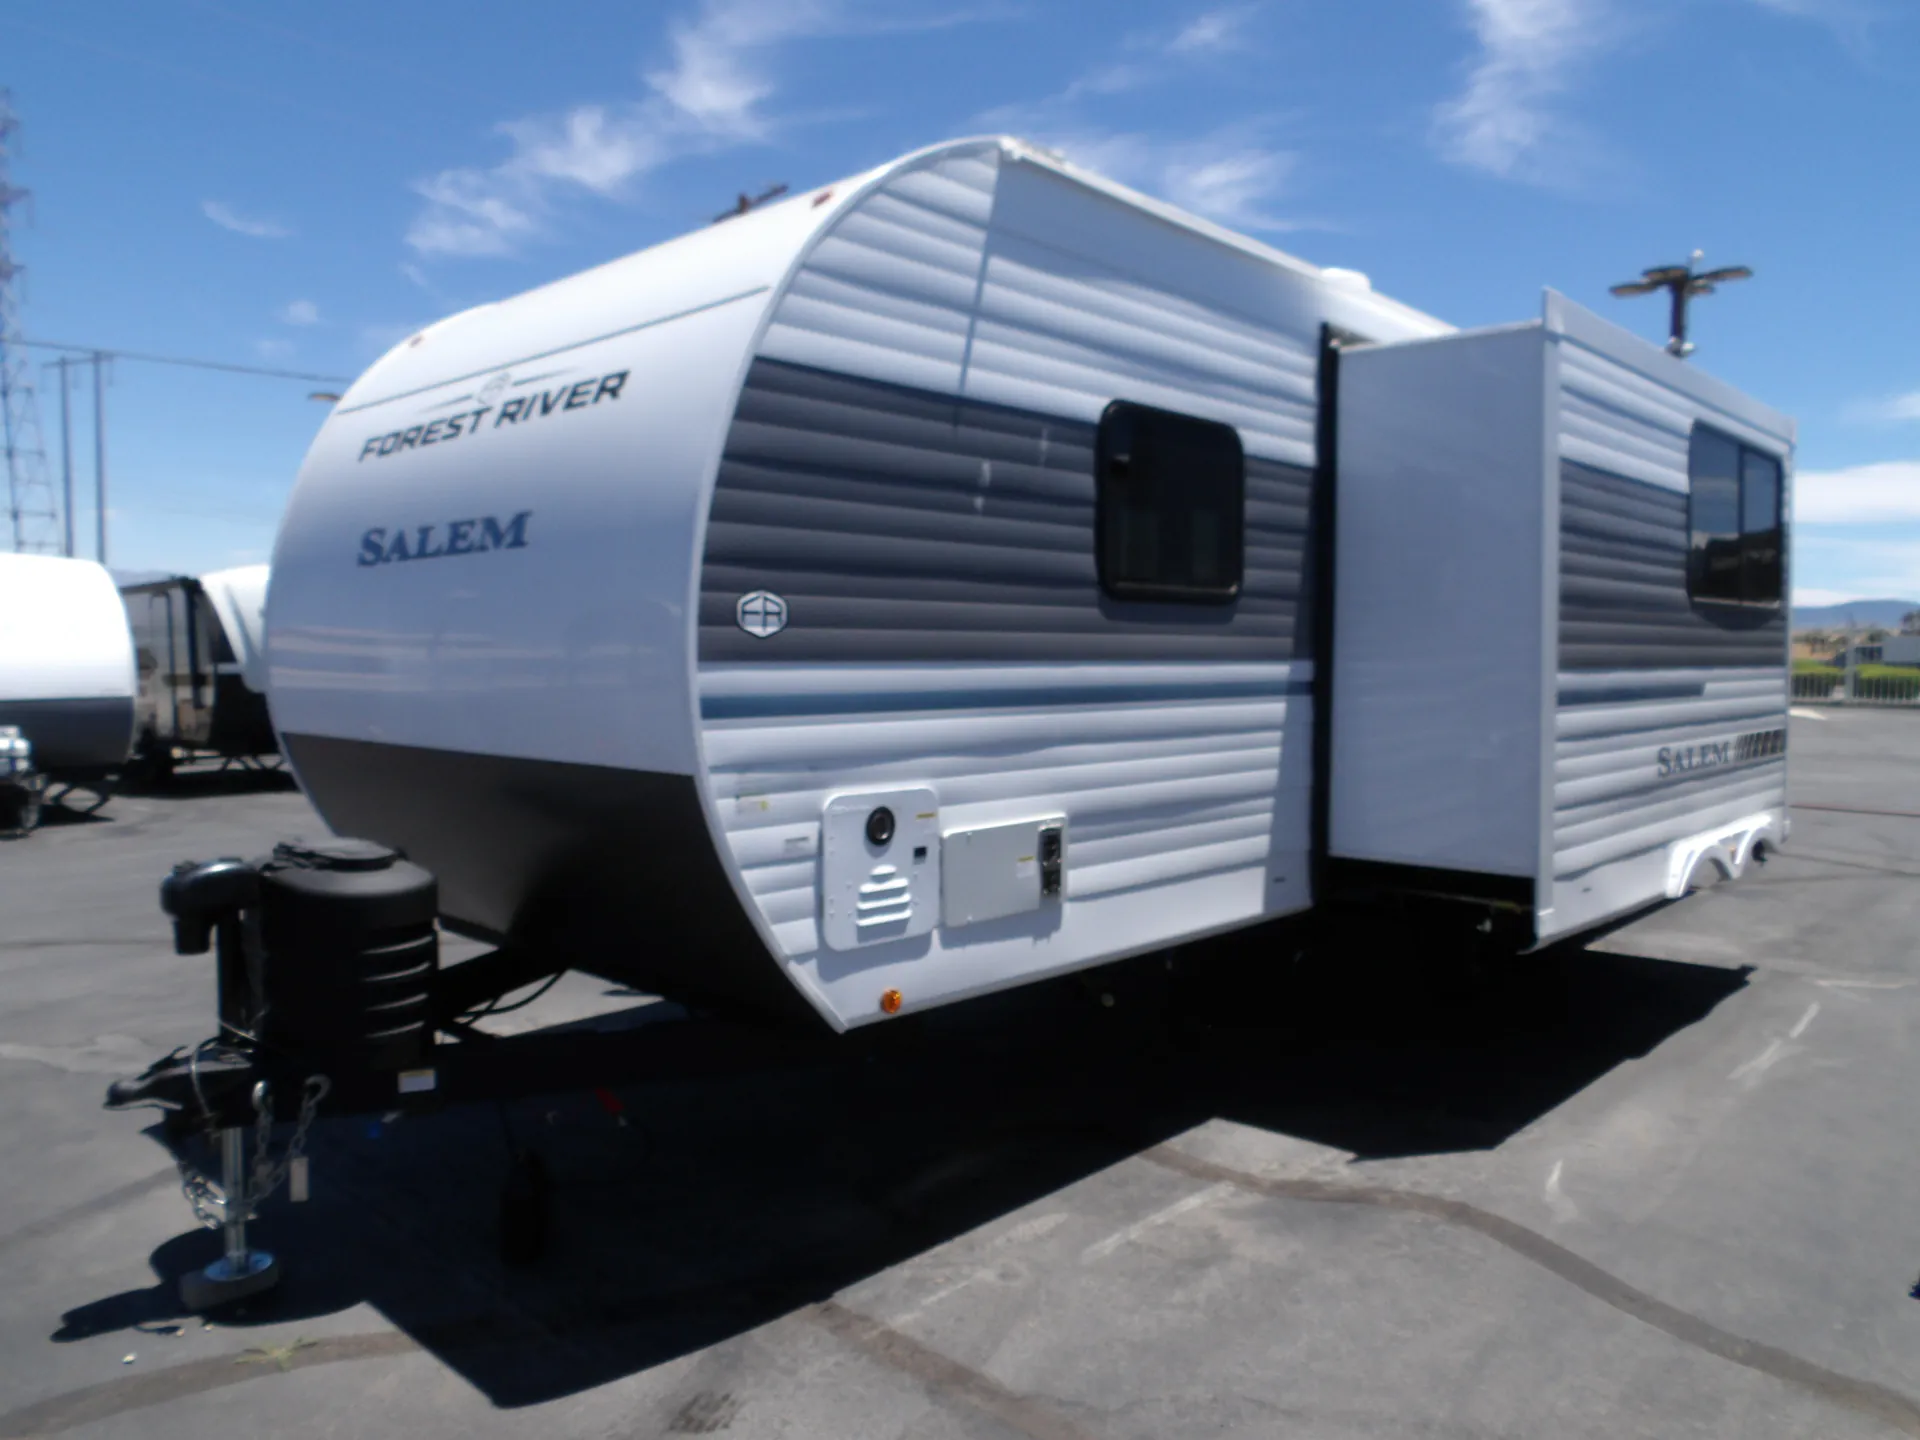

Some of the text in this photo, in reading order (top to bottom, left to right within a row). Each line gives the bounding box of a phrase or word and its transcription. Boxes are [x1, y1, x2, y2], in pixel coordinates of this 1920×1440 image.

[358, 369, 630, 462] FOREST RIVER
[357, 510, 533, 567] SALEM
[1657, 740, 1731, 778] SALEM
